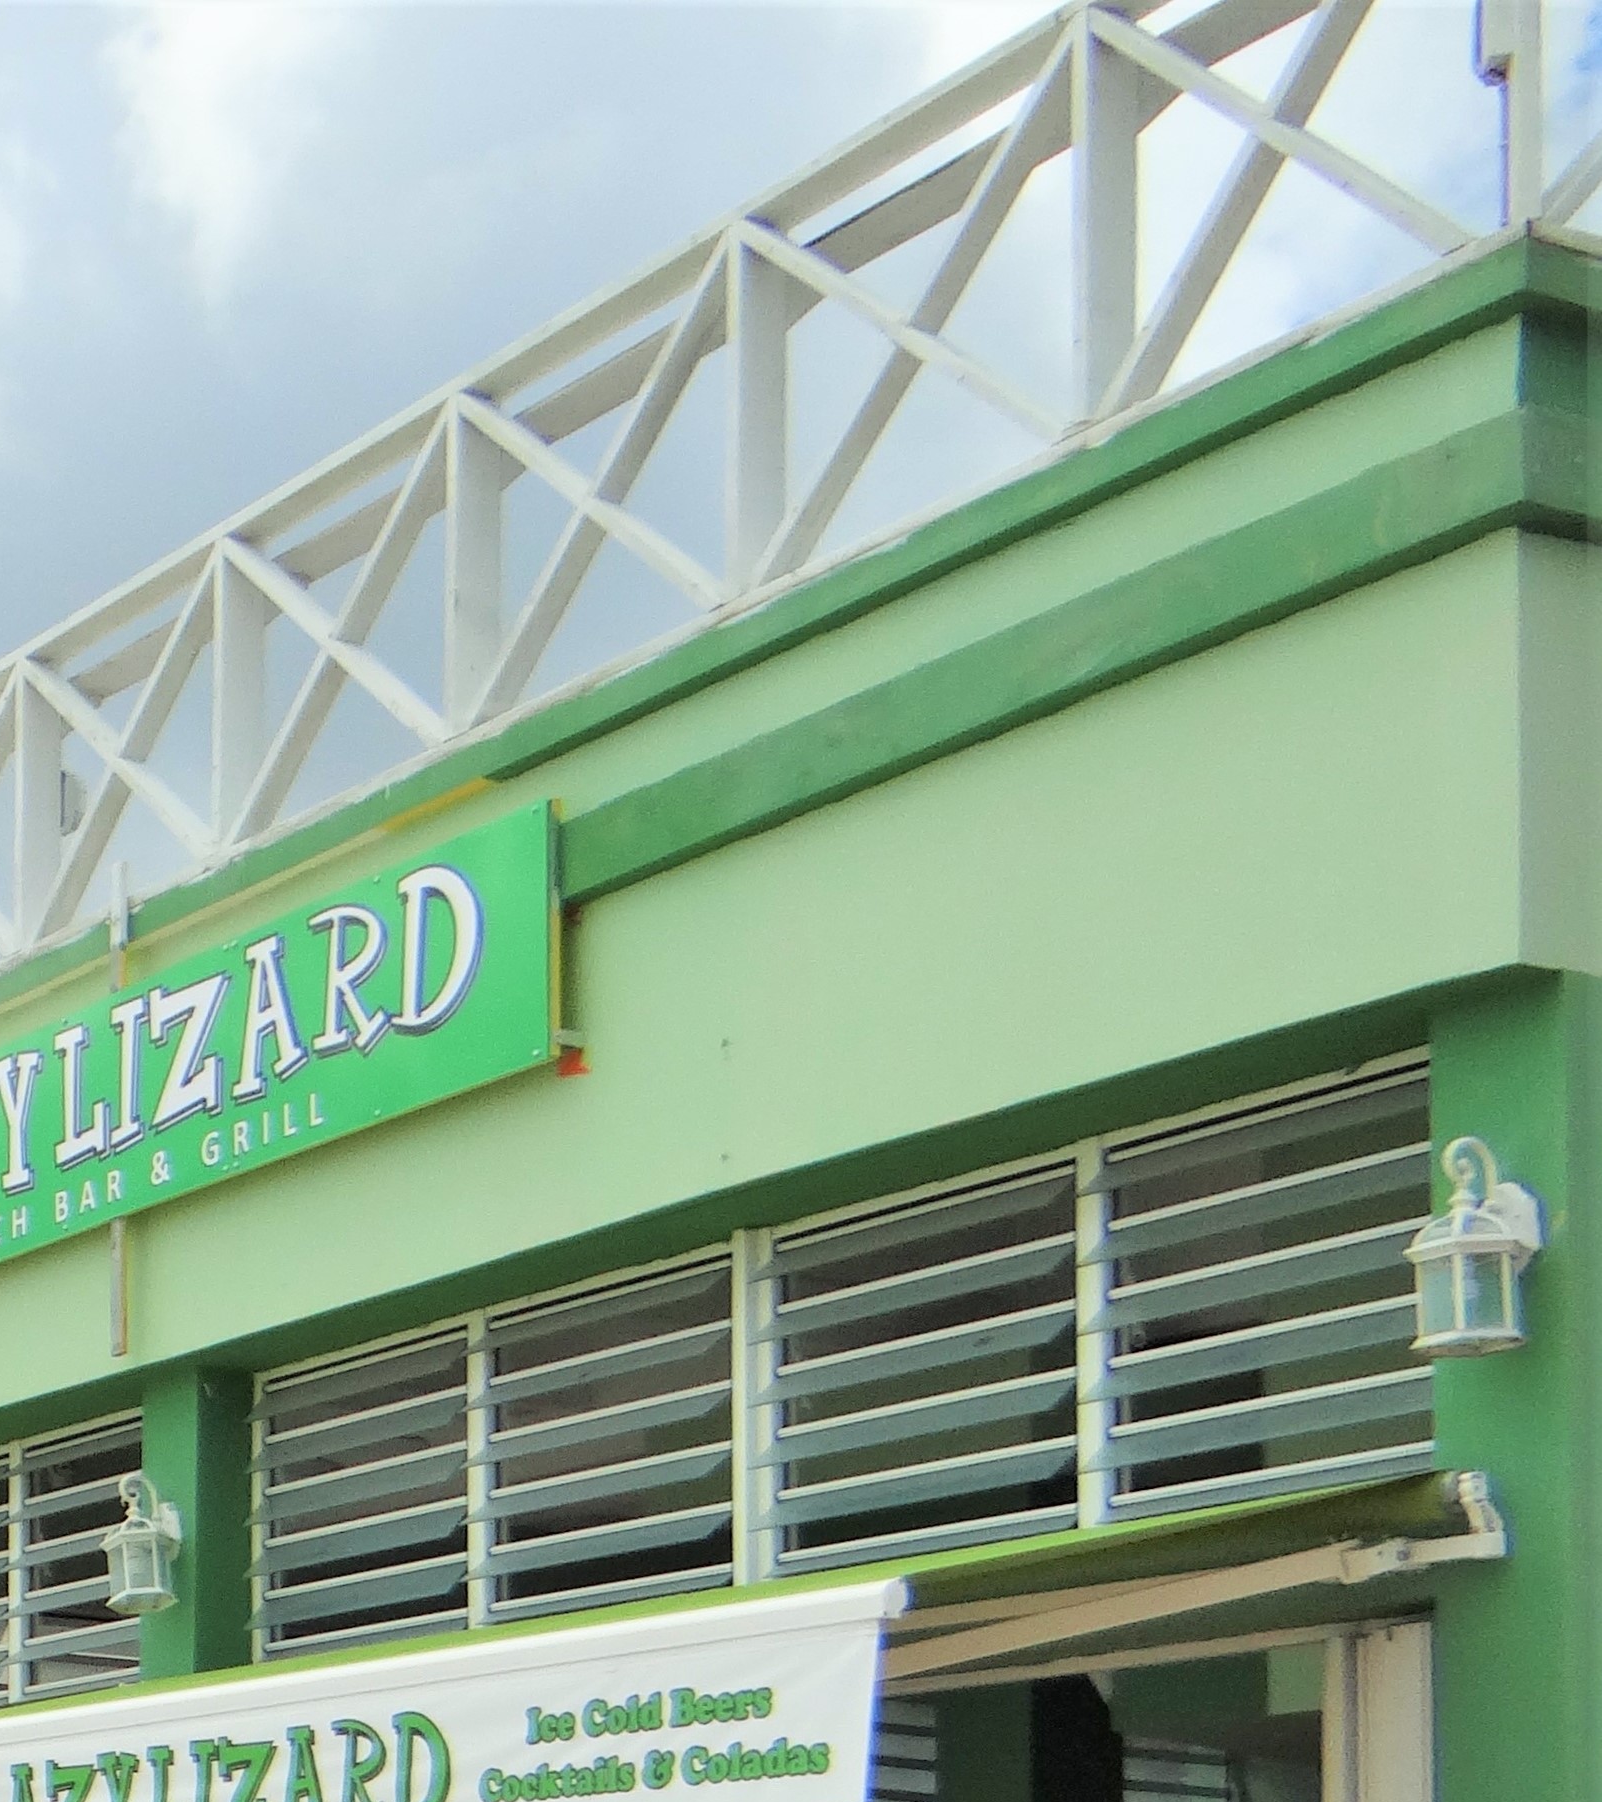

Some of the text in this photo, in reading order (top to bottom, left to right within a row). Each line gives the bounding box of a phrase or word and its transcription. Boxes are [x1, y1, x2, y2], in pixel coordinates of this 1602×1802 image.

[54, 1169, 124, 1225] BAR
[150, 1150, 171, 1185] &
[200, 1092, 326, 1167] GRILL
[525, 1686, 773, 1745] Ice Cold Beers
[642, 1750, 676, 1788] &
[680, 1737, 831, 1786] Coladas
